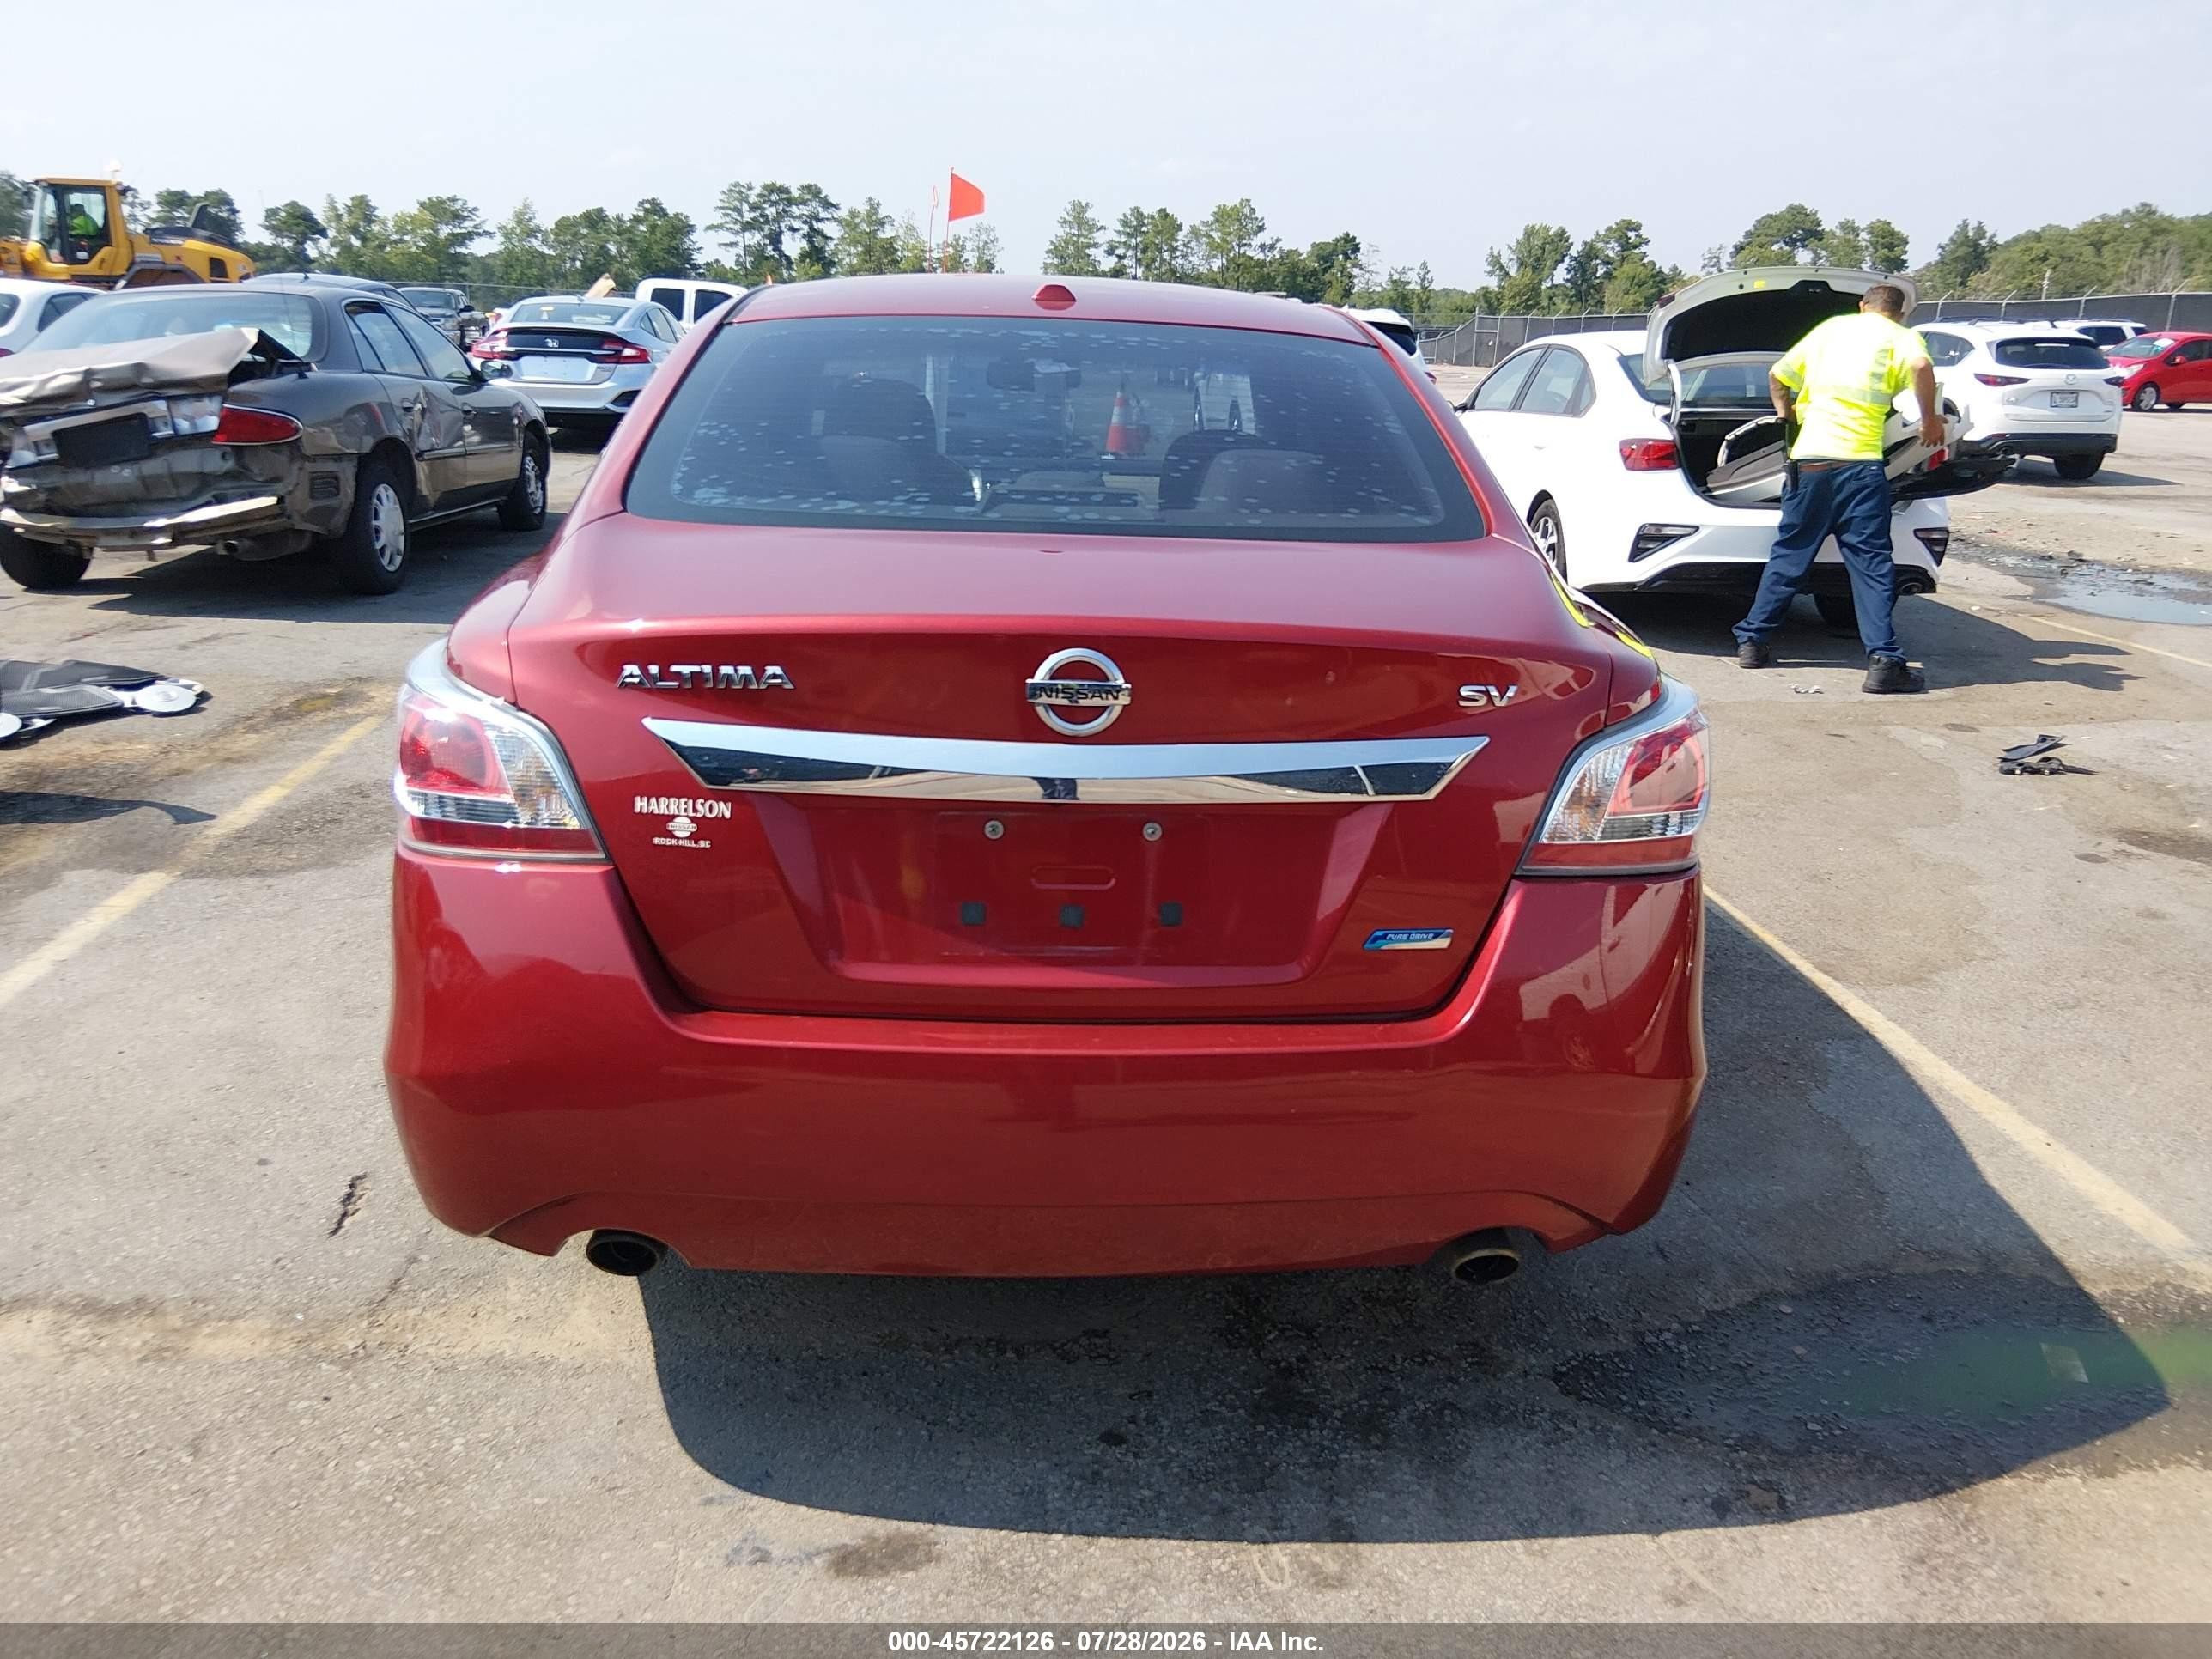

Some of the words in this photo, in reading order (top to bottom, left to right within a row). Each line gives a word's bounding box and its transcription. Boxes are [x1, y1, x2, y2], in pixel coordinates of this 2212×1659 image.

[617, 664, 795, 690] ALTIMA
[1036, 686, 1122, 701] NISSAN
[1458, 685, 1518, 707] SV
[634, 795, 732, 819] HARRELSON
[653, 837, 678, 846] ROCK
